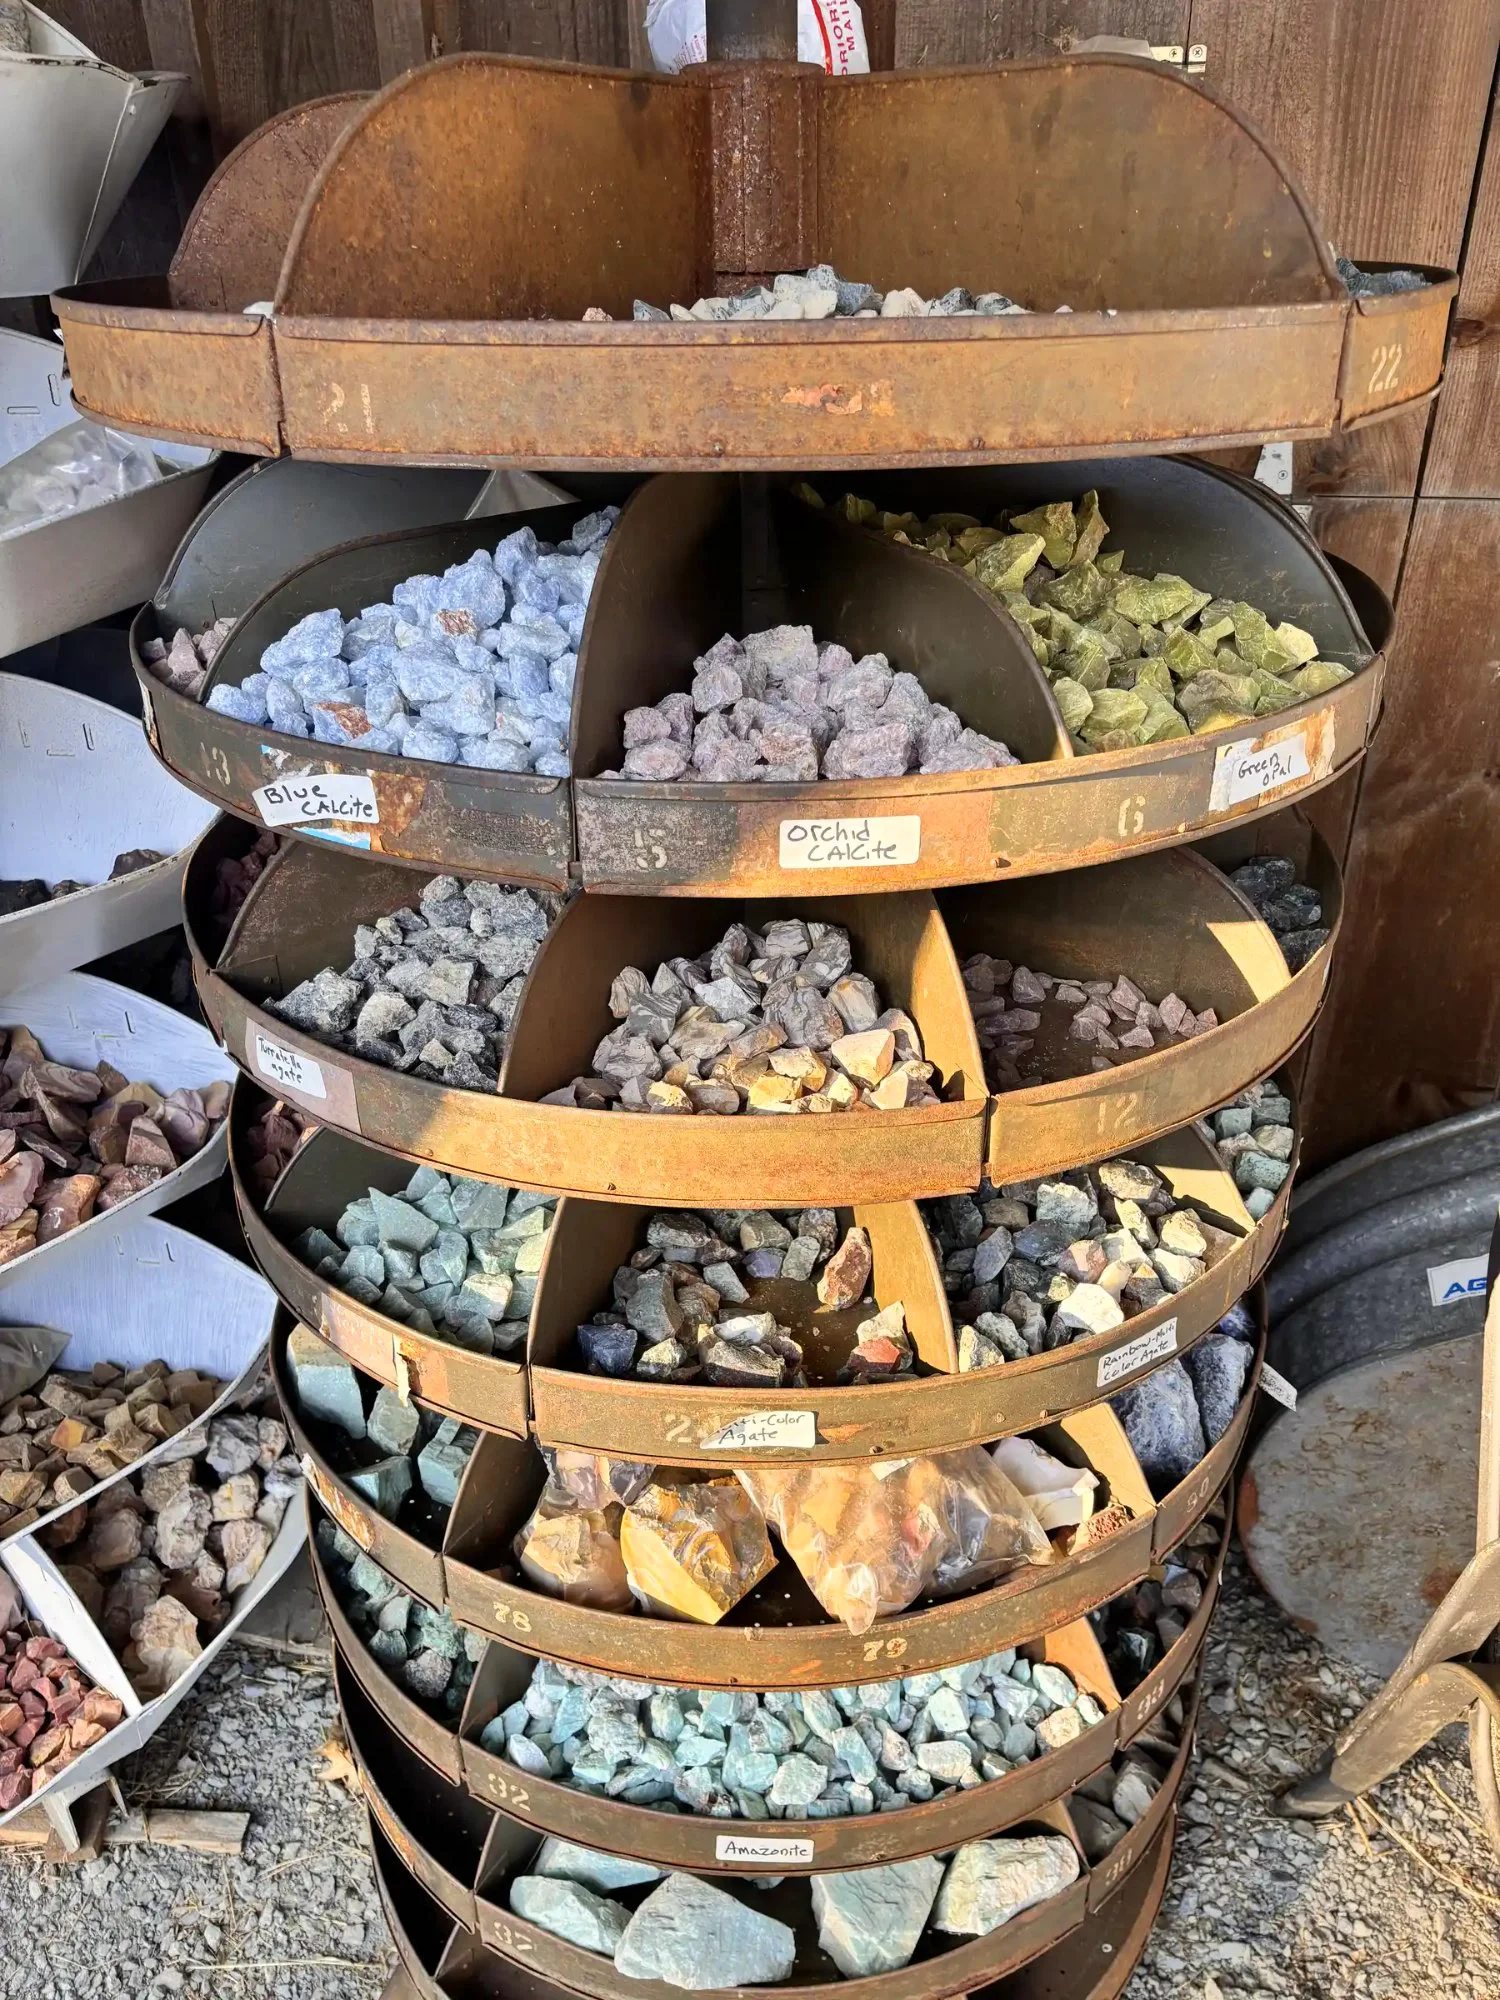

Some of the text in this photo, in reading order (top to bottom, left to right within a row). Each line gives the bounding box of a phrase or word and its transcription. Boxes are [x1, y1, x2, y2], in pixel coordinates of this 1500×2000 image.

[1368, 343, 1403, 395] 22
[1238, 752, 1279, 779] Green
[264, 784, 328, 804] Blue
[787, 819, 870, 842] Orchid
[1097, 1092, 1138, 1136] 12
[718, 1427, 778, 1446] Agate
[487, 1773, 531, 1812] 32
[724, 1840, 810, 1857] Amazonite
